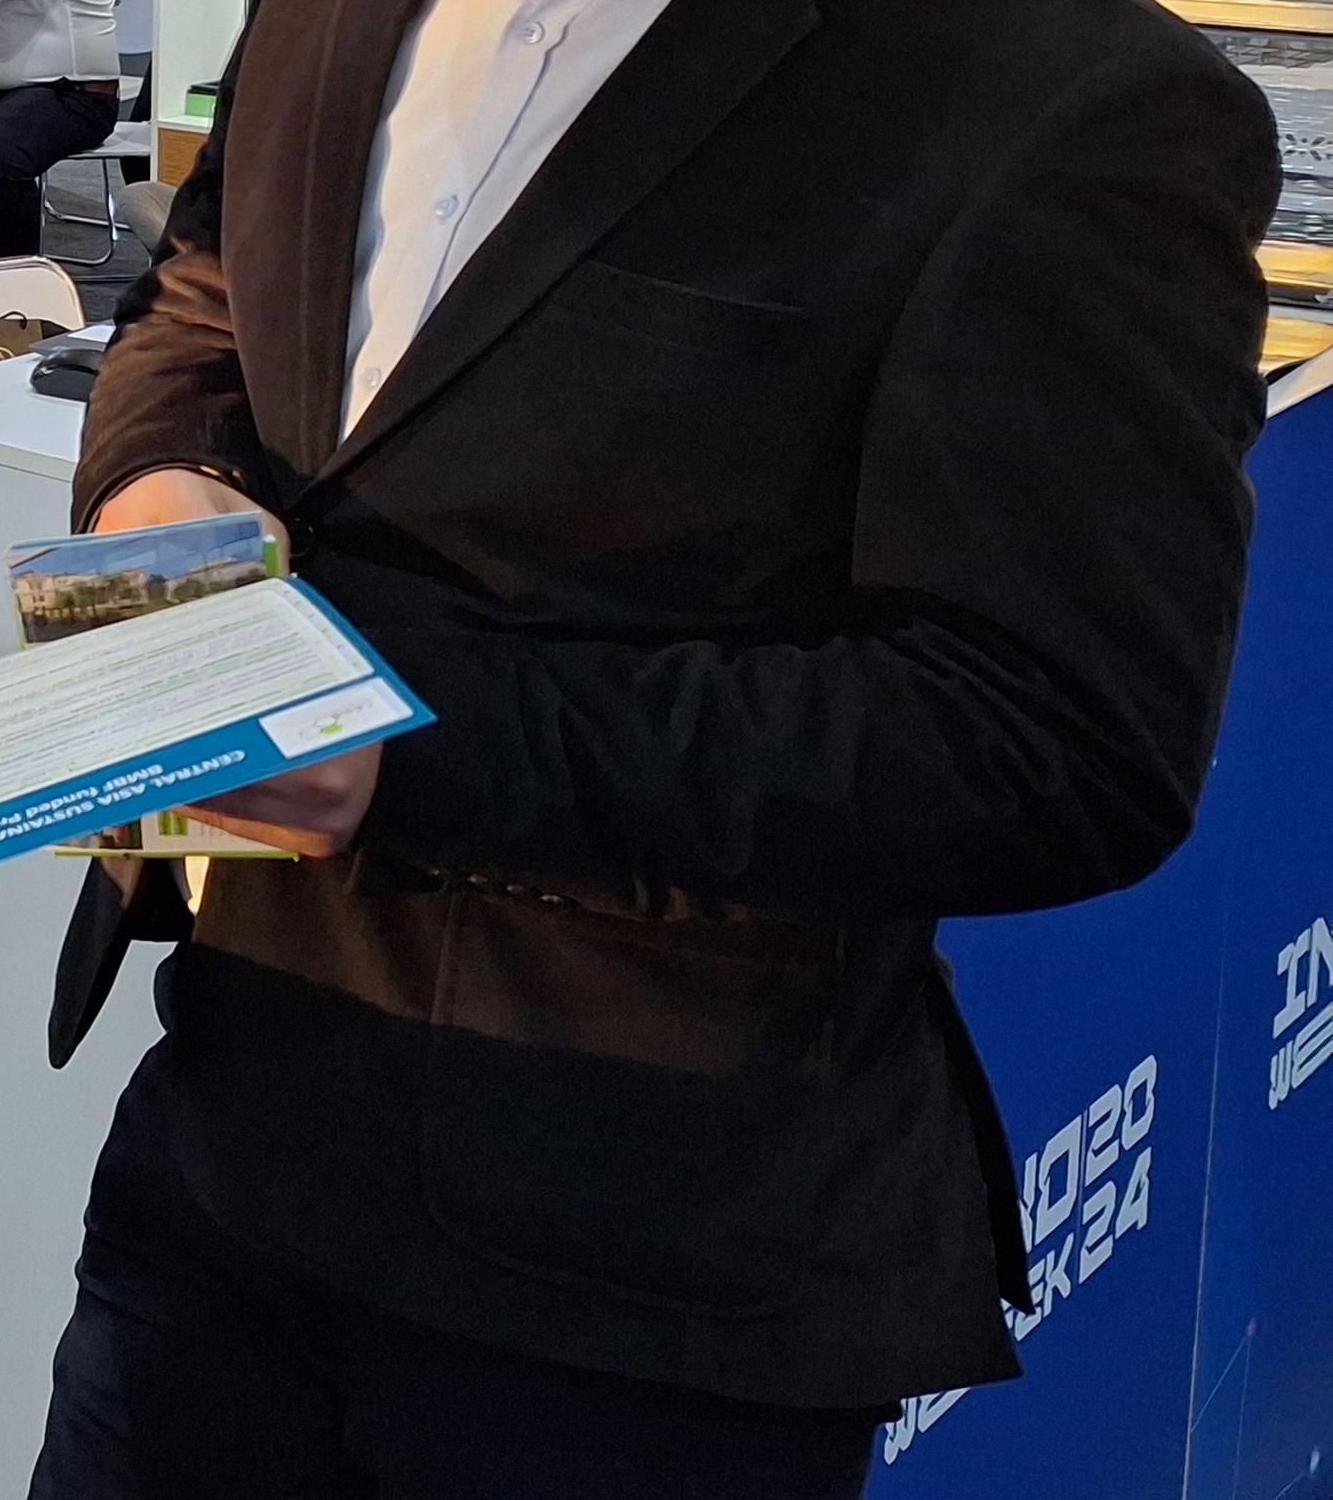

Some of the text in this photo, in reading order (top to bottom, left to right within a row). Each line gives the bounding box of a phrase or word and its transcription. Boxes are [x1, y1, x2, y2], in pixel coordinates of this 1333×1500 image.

[102, 764, 165, 793] BMBF
[149, 749, 246, 788] CENTRAL
[25, 786, 100, 818] funded
[96, 782, 147, 806] ASIA
